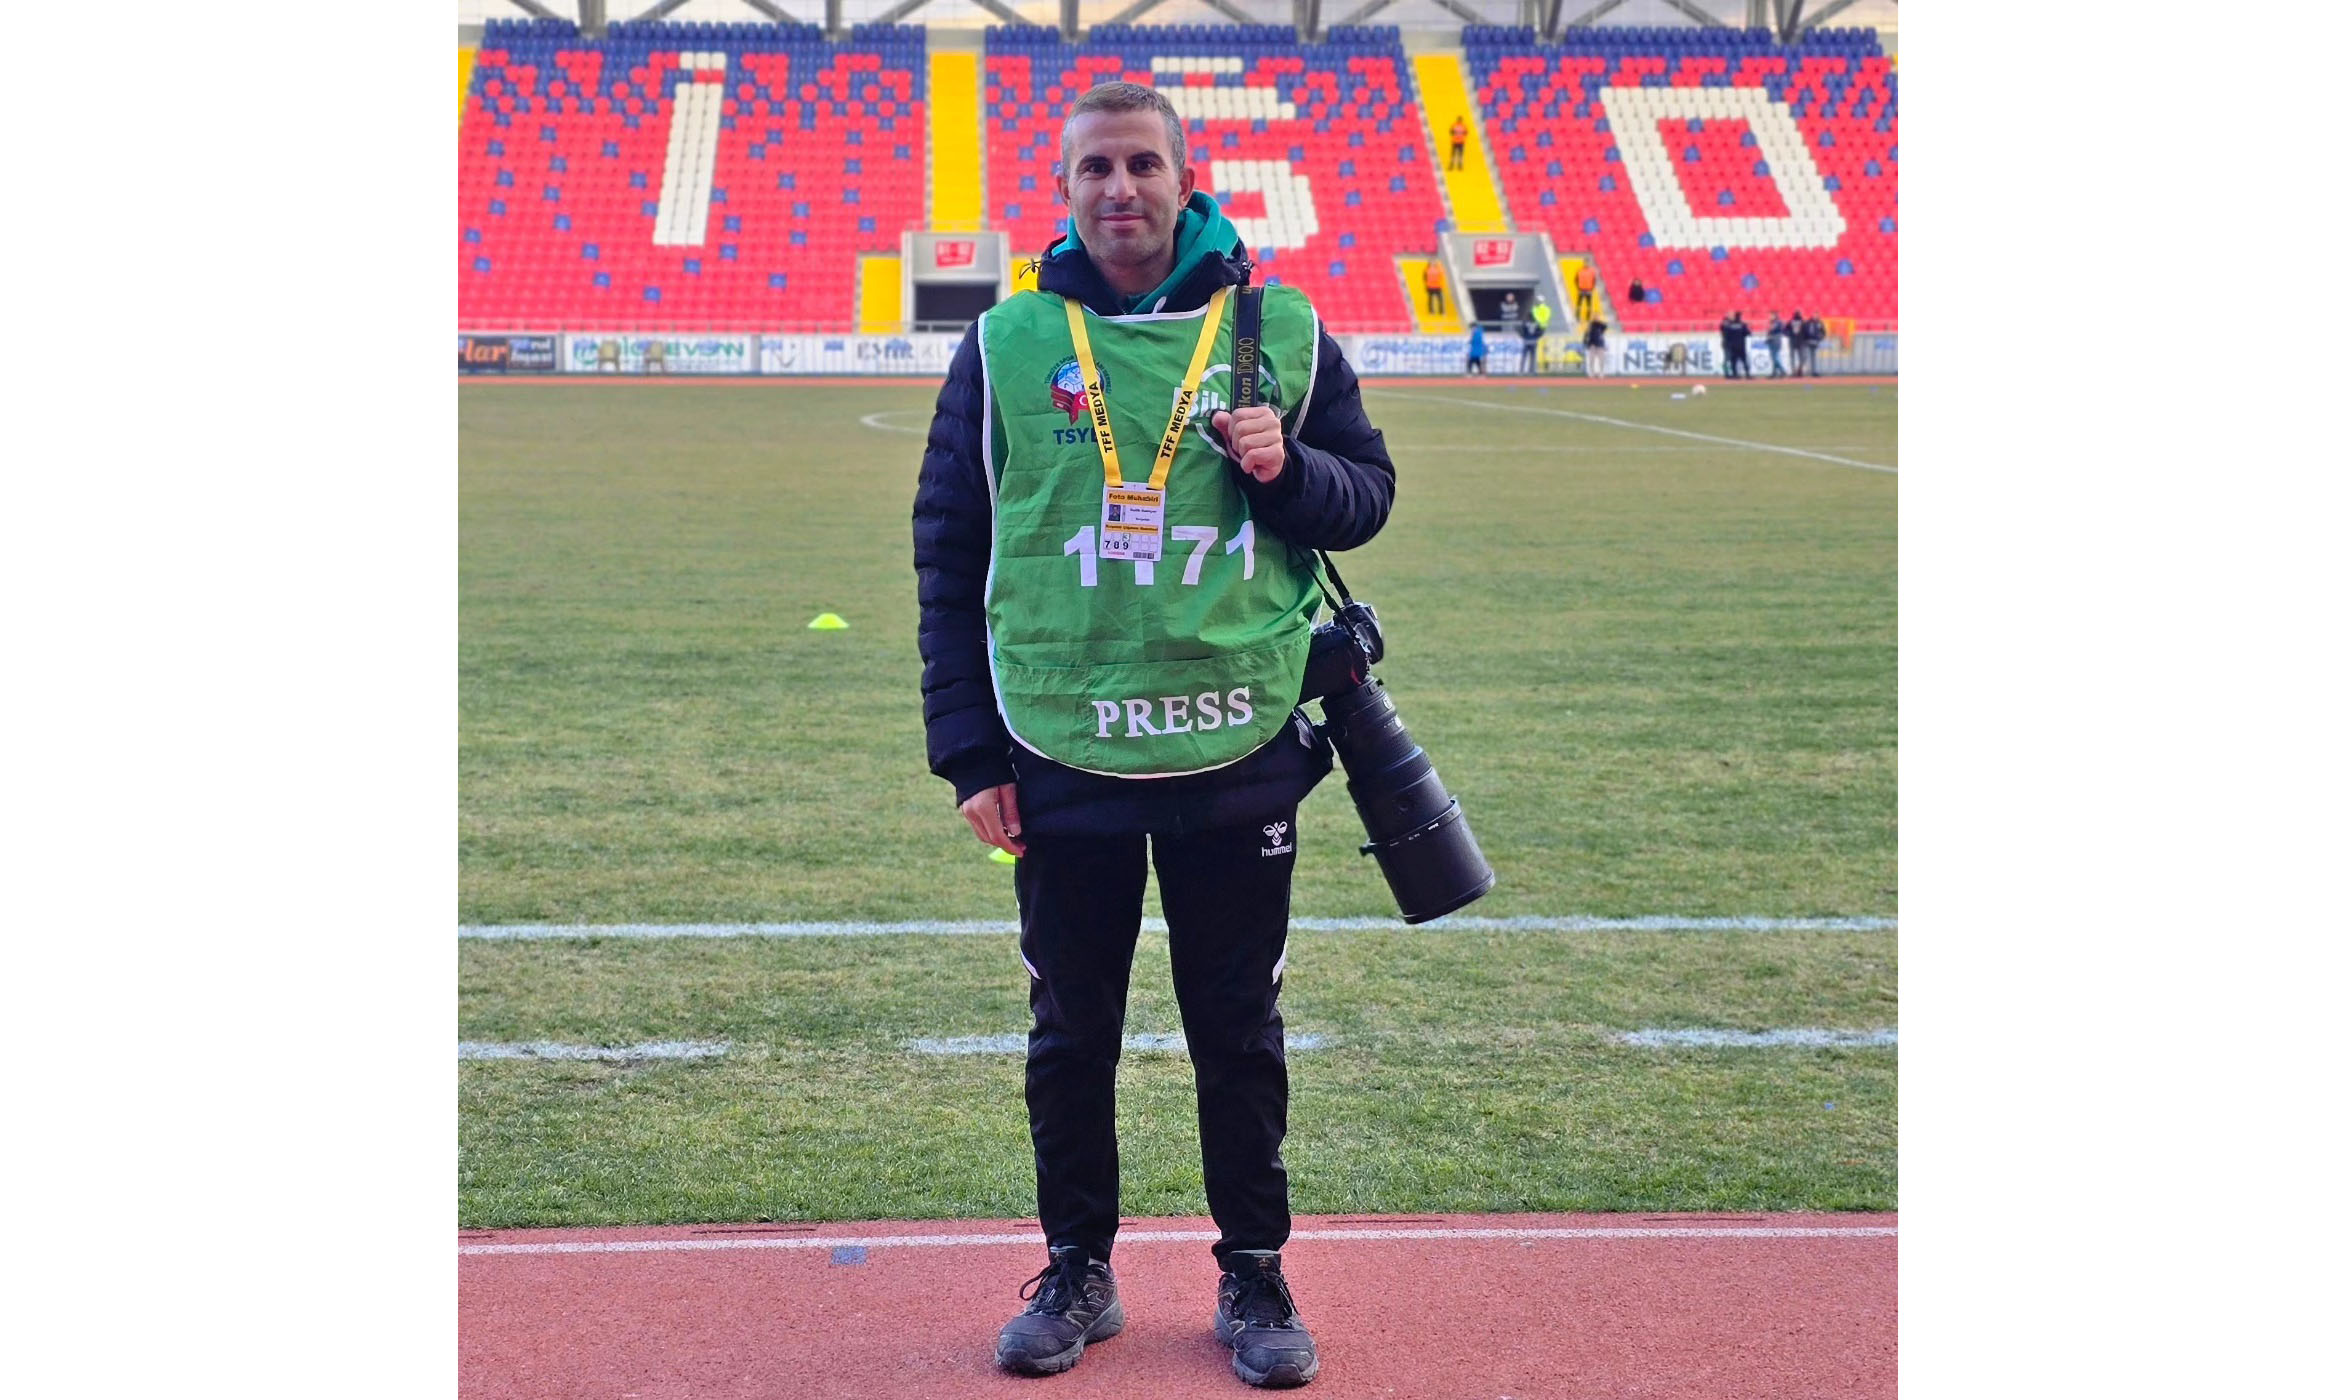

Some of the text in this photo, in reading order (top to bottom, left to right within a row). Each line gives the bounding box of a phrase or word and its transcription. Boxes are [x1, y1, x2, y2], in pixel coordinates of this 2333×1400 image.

[1237, 337, 1254, 408] ikon D600
[1623, 351, 1712, 371] NESNE
[1089, 381, 1108, 427] MEDYA
[1160, 390, 1193, 459] TFF MEDYA
[1101, 430, 1114, 454] TFF
[1091, 685, 1254, 738] PRESS
[1261, 841, 1292, 857] hummel
